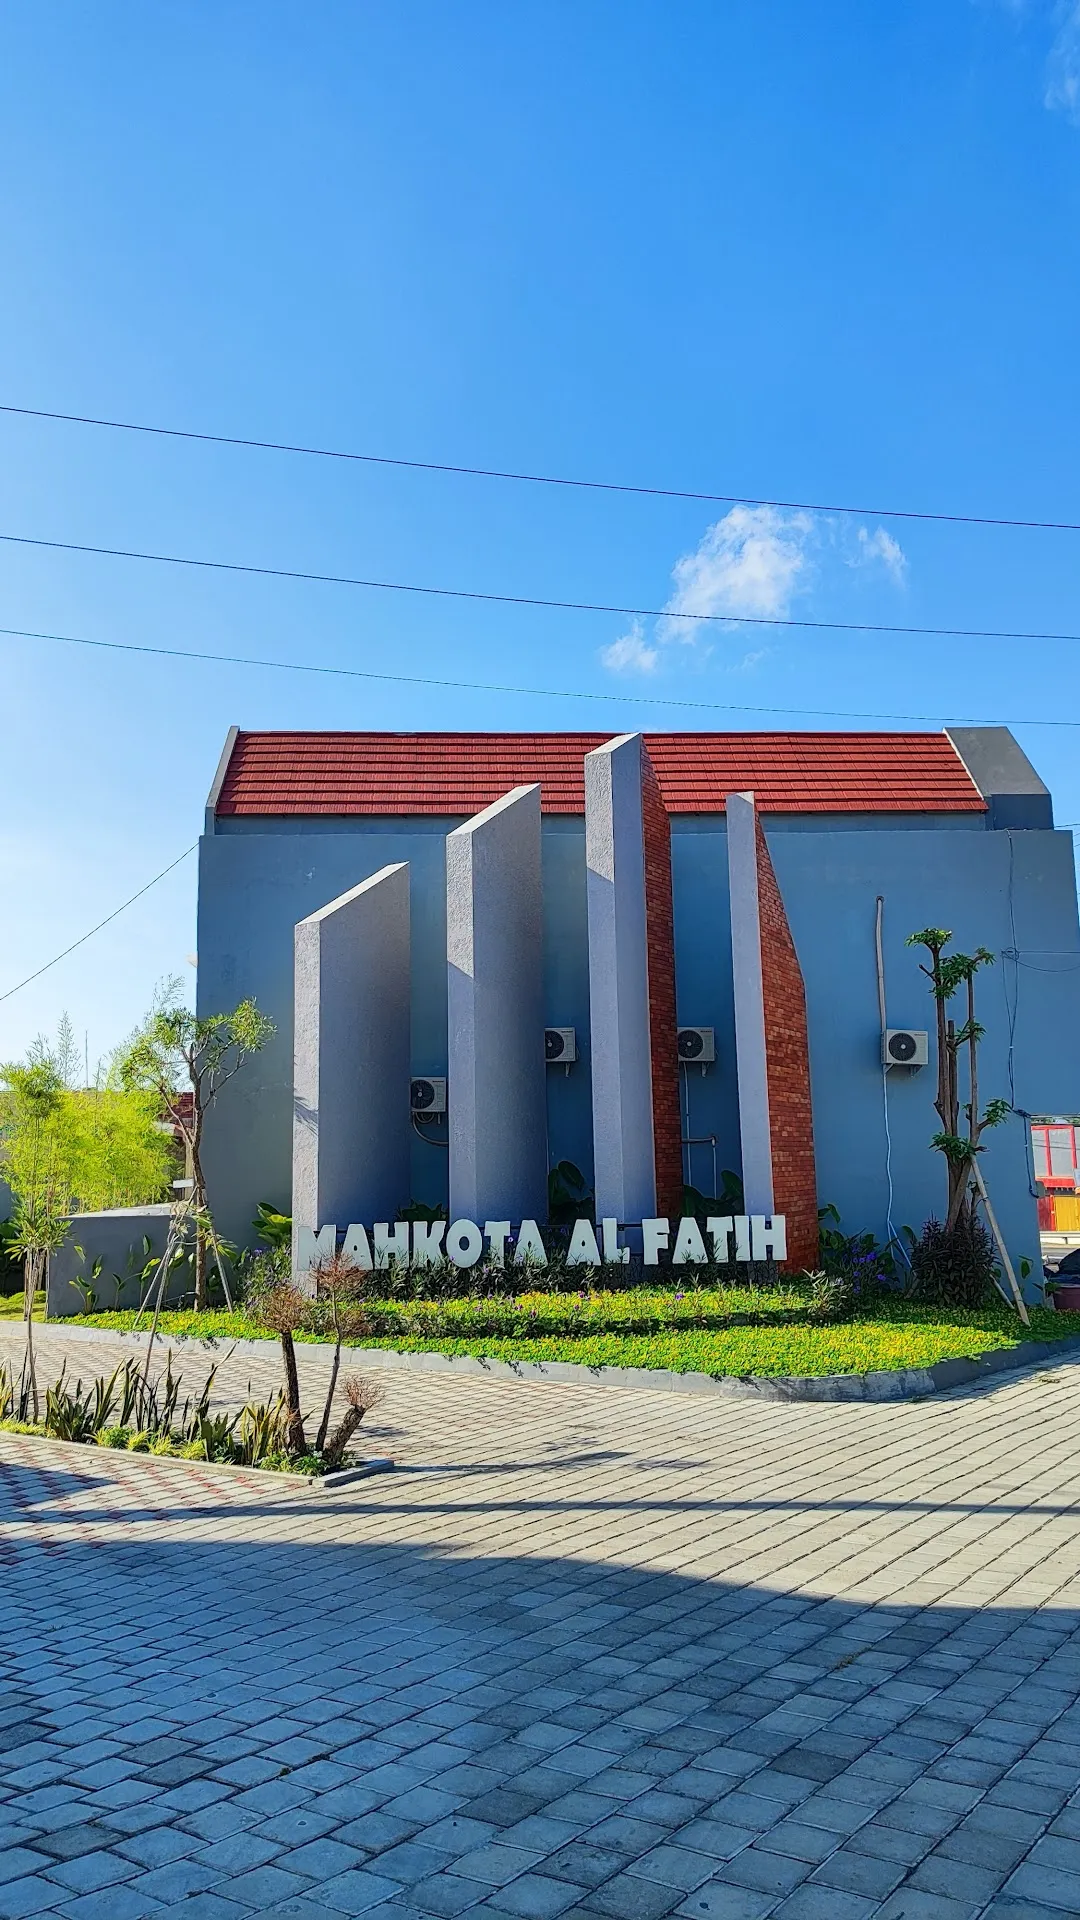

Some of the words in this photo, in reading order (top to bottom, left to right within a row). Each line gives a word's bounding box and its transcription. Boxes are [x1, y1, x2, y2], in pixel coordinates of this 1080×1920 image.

[297, 1218, 549, 1271] MAHKOTA
[566, 1218, 630, 1266] AL
[642, 1215, 787, 1265] FATIH
